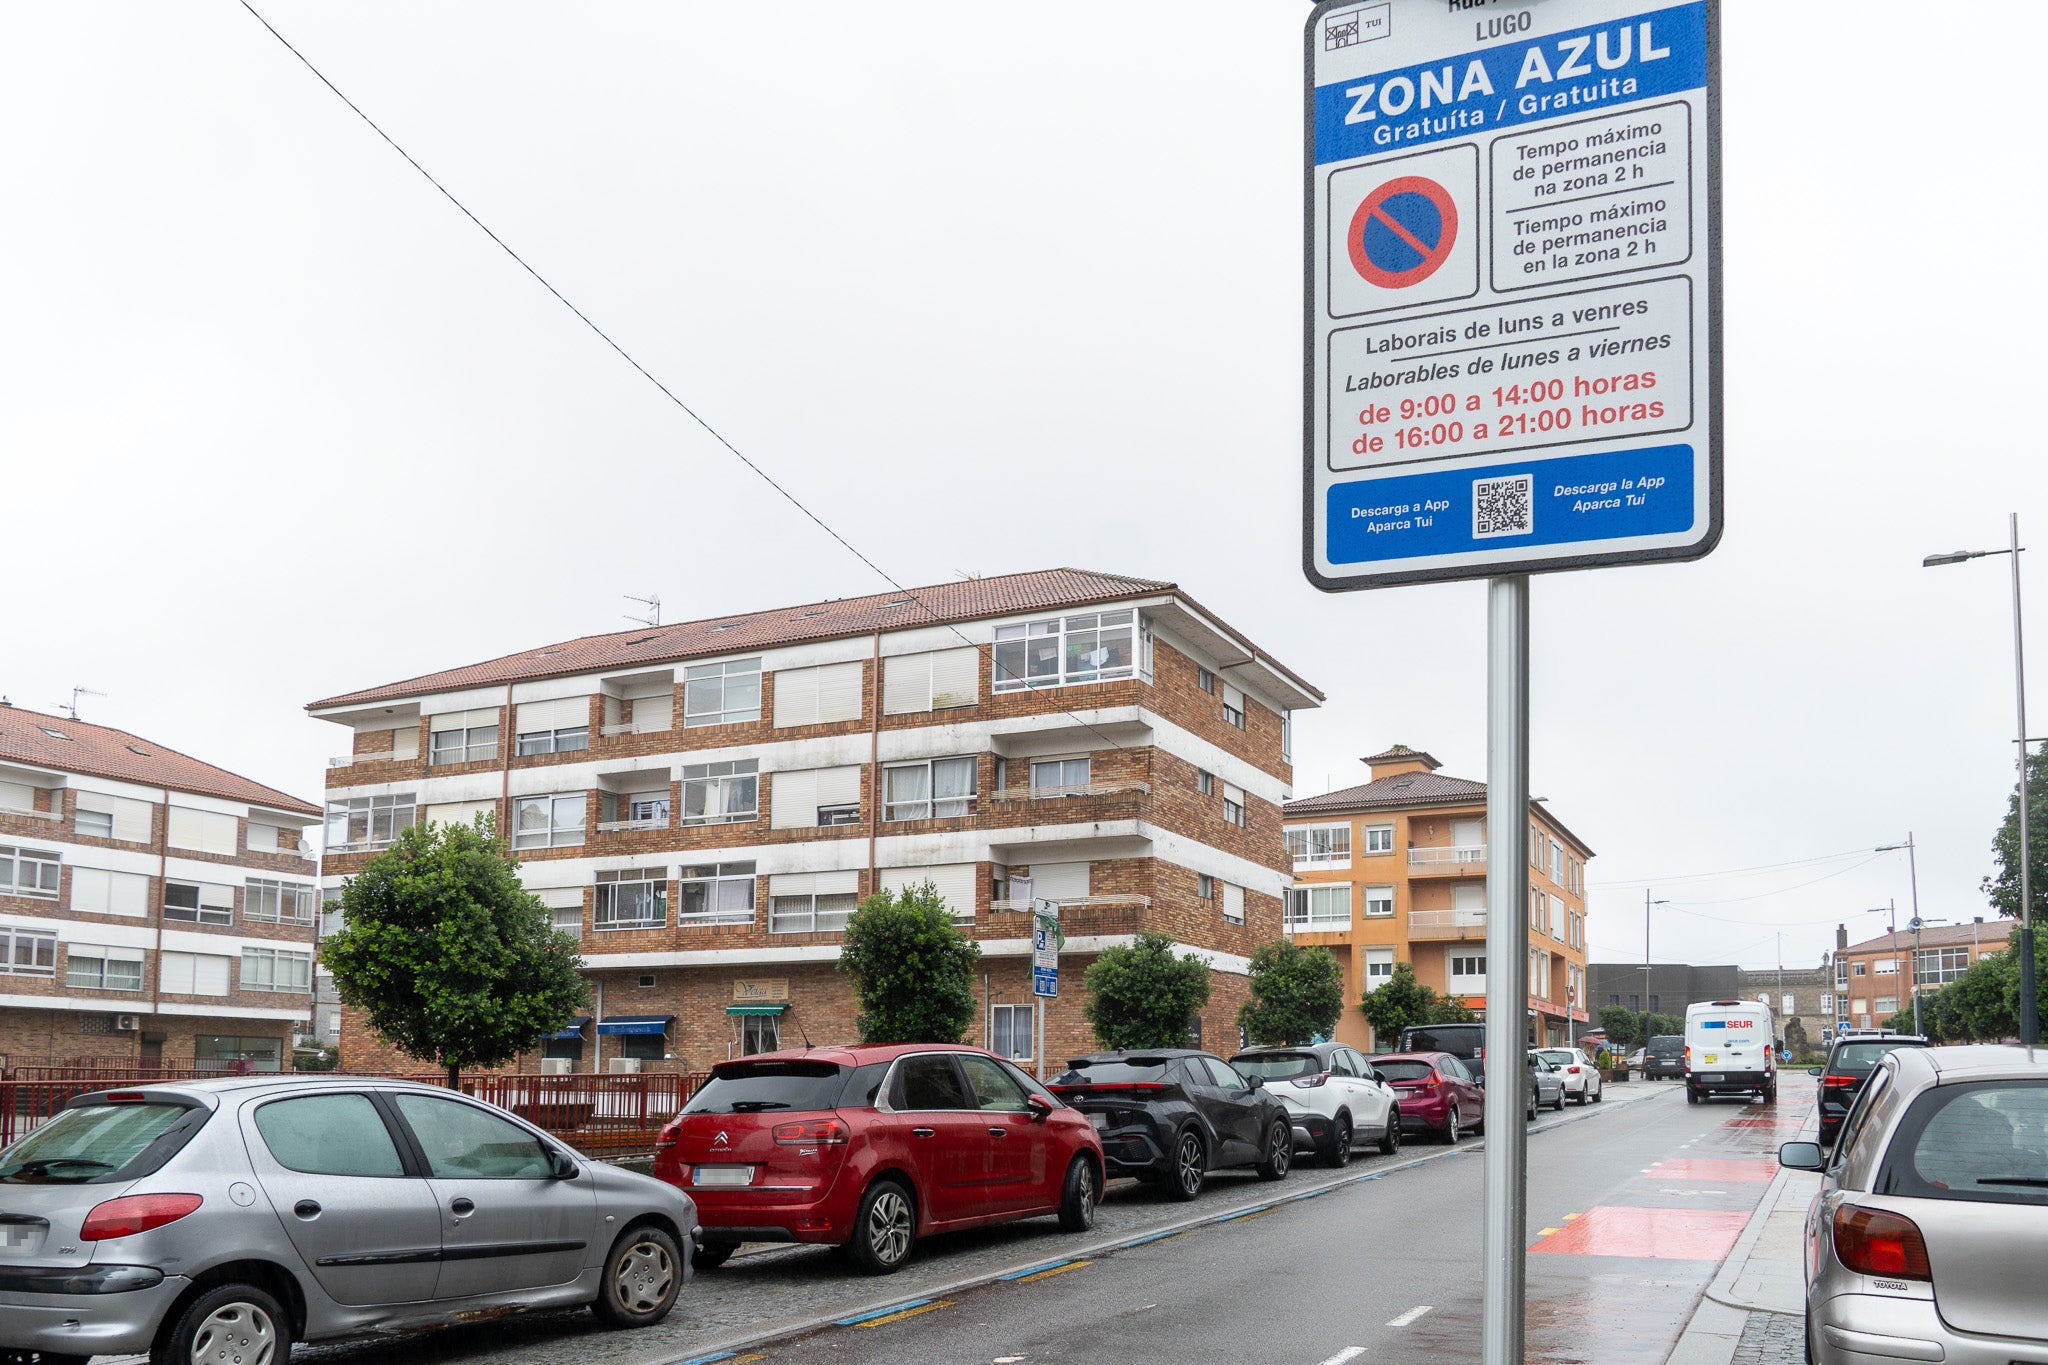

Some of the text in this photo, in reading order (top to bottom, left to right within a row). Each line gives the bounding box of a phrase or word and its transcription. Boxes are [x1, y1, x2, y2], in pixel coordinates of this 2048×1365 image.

[1366, 18, 1381, 28] TUI
[1477, 11, 1531, 41] LUGO
[1345, 22, 1670, 125] ZONA AZUL
[1374, 78, 1636, 144] Gratuíta / Gratuita
[1516, 124, 1661, 160] Tempo máximo
[1513, 142, 1667, 181] de permanencia
[1535, 164, 1643, 196] na zona 2 h
[1514, 200, 1666, 235] Tiempo máximo
[1514, 218, 1667, 255] de permanencia
[1524, 239, 1655, 273] en la zona 2 h
[1367, 300, 1648, 354] Laborais de luns a venres
[1346, 335, 1671, 392] Laborables de lunes a viernes
[1360, 372, 1656, 425] de 9:00 a 14:00 horas
[1352, 402, 1664, 454] de 16:00 a 21:00 horas
[1554, 477, 1664, 496] Descarga la App
[1573, 494, 1645, 513] Aparca Tui
[1352, 500, 1449, 518] Descarga a App
[1367, 516, 1432, 534] Aparca Tui
[1727, 1020, 1753, 1028] SEUR
[1873, 1280, 1908, 1290] TOYOTA
